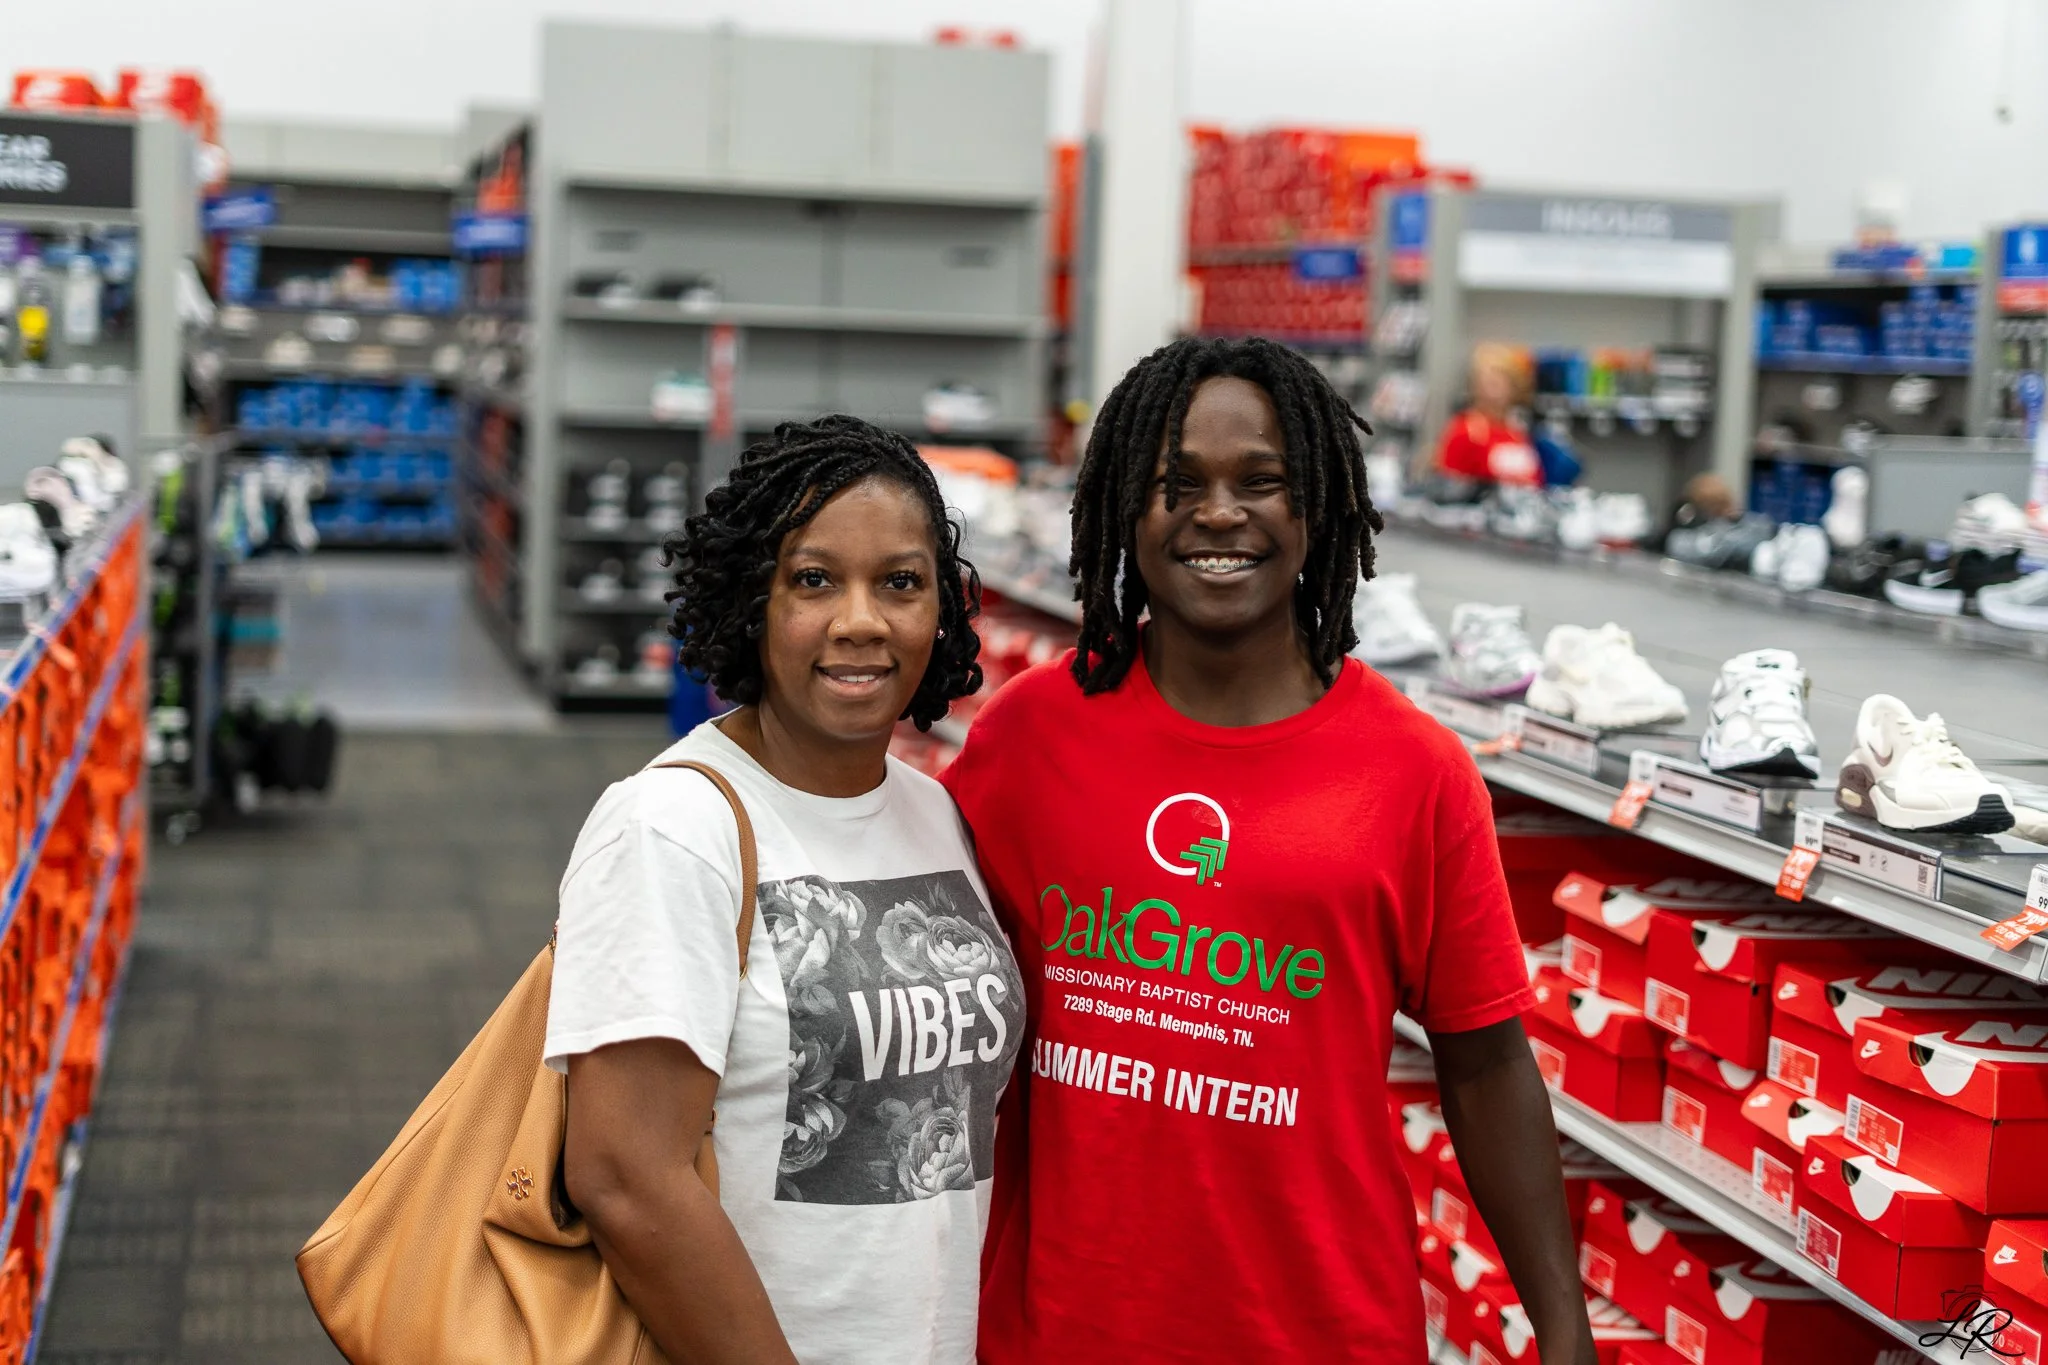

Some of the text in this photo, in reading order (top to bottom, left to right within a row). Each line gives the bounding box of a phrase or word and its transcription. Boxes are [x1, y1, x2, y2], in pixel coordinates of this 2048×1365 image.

[1040, 884, 1326, 999] OakGrove
[848, 973, 1007, 1083] VIBES
[1064, 994, 1255, 1048] 7289 Stage Rd. Memphis, TN.
[1139, 981, 1214, 1010] BAPTIST
[1217, 998, 1291, 1025] CHURCH
[1163, 1067, 1299, 1127] INTERN
